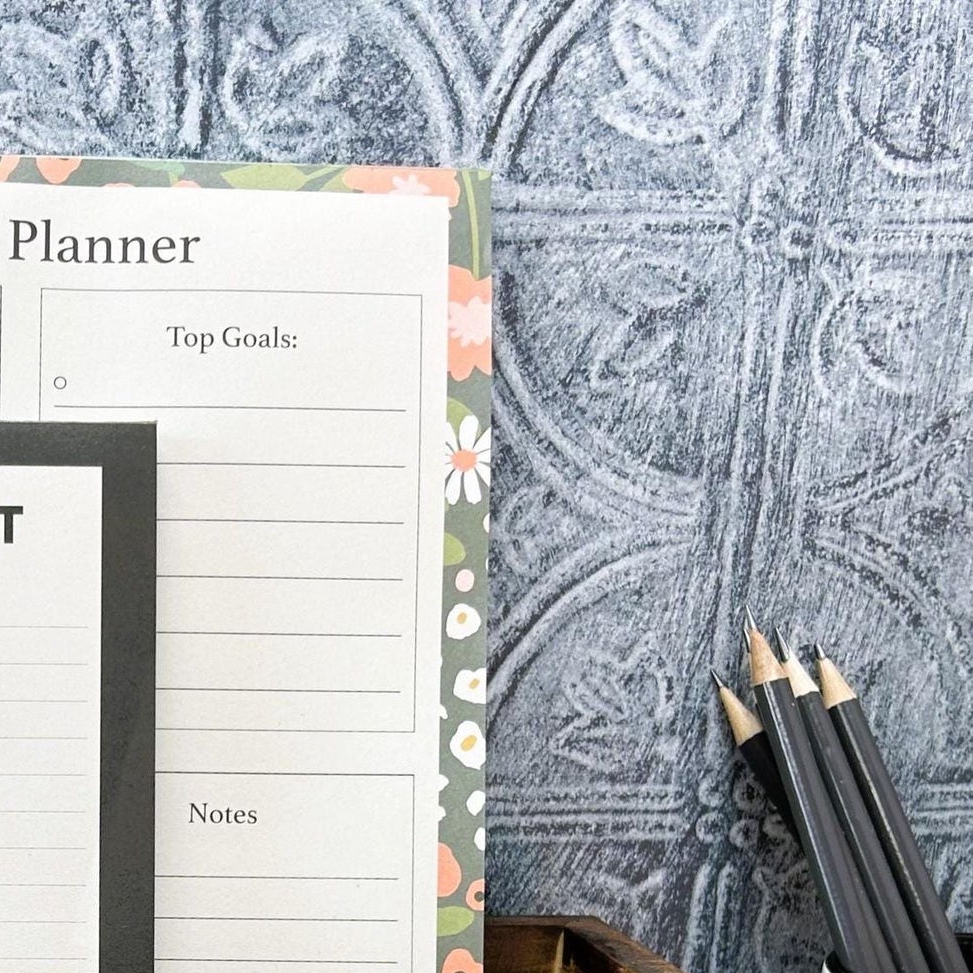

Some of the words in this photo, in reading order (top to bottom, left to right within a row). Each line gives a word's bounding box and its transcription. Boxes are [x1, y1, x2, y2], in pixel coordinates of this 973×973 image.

[8, 219, 201, 264] Planner
[166, 325, 215, 354] Top
[222, 326, 298, 350] Goals:
[188, 801, 259, 825] Notes
